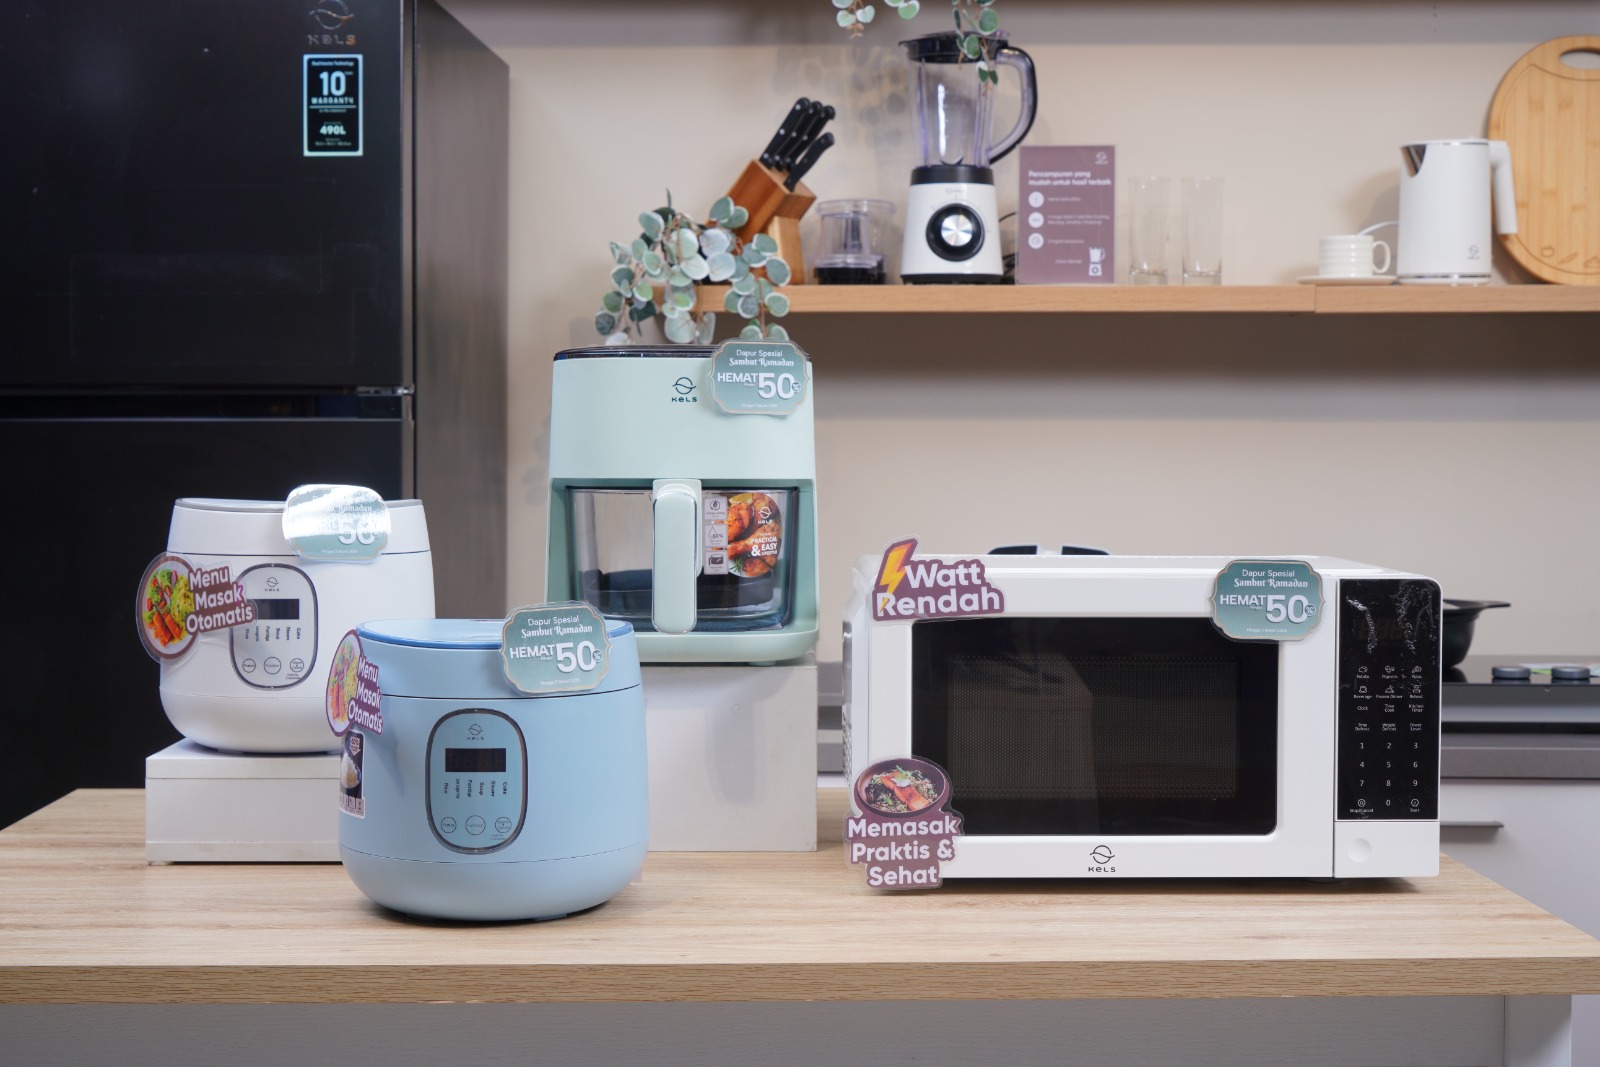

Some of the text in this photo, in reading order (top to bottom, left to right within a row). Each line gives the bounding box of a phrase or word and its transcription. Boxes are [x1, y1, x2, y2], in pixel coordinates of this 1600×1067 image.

[320, 71, 346, 96] 10
[320, 125, 346, 135] 490L
[730, 358, 794, 367] Sambut Ramadan
[736, 350, 756, 358] Dapur
[717, 373, 758, 382] HEMAT
[751, 545, 761, 556] &
[190, 568, 228, 590] Menu
[905, 563, 982, 588] Watt
[1234, 578, 1308, 588] Sambut Ramadan
[1242, 569, 1295, 578] Dapur Spesial
[194, 584, 246, 611] Masak
[876, 586, 1000, 617] Rendah
[1220, 595, 1266, 606] HEMAT
[186, 605, 253, 633] Otomatis
[528, 615, 579, 627] Dapur Spesial
[522, 624, 593, 639] Sambut Ramadan
[510, 644, 555, 659] HEMAT
[358, 656, 378, 683] Menu
[356, 681, 380, 709] Masak
[349, 700, 382, 734] Otomatis
[848, 816, 958, 838] Memasak
[852, 839, 952, 862] Praktis &
[868, 866, 937, 886] Sehat
